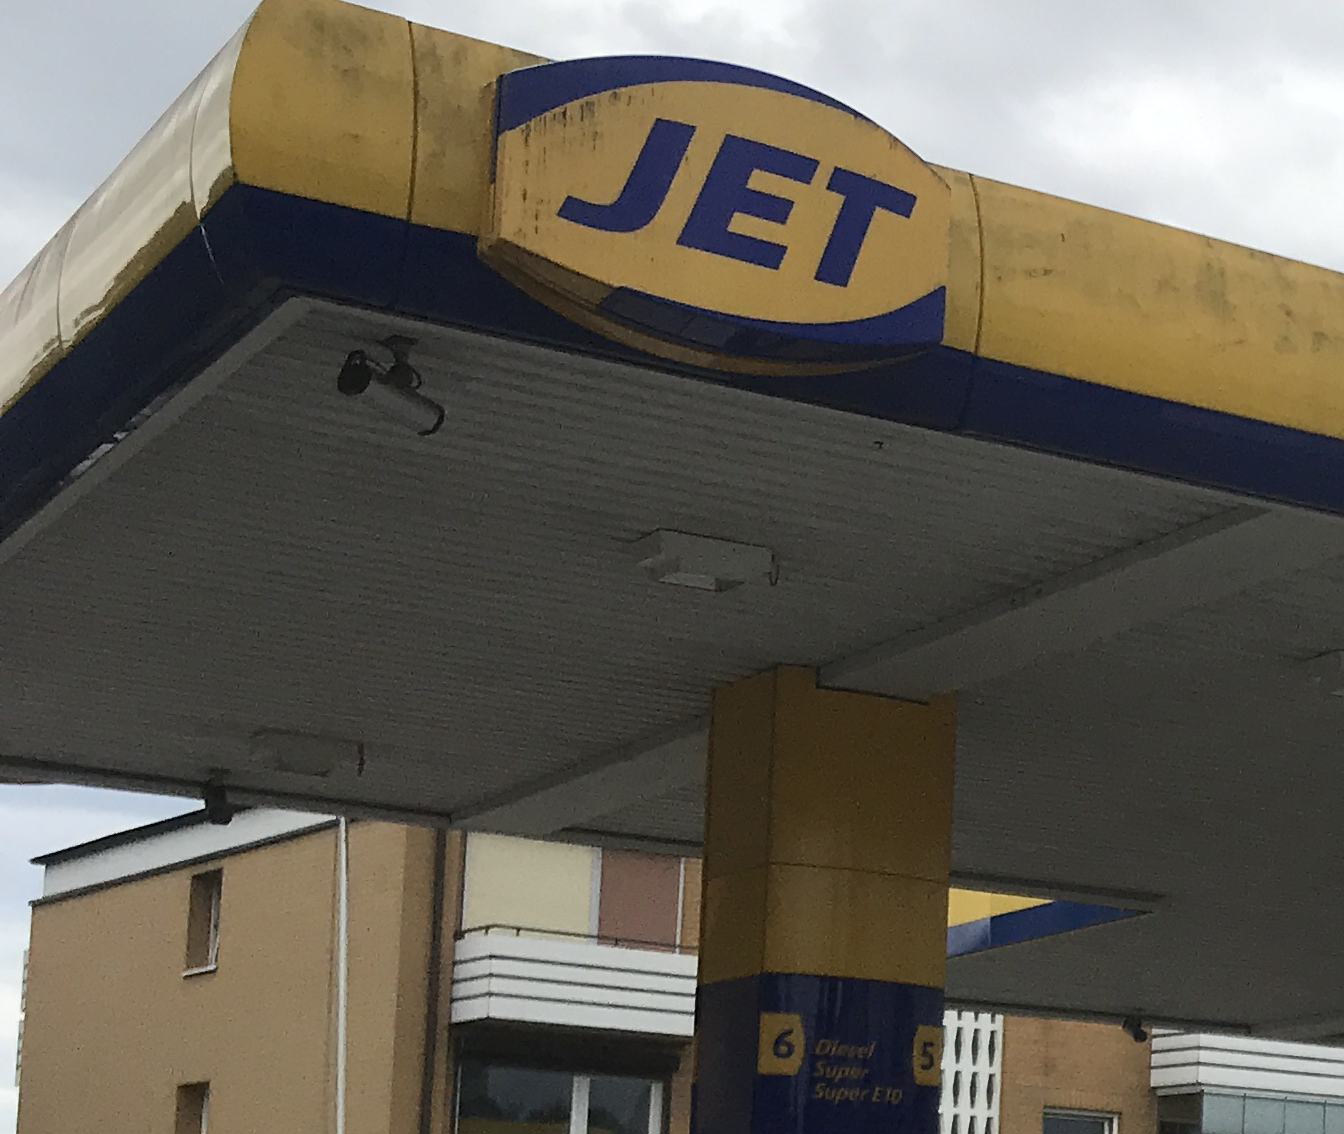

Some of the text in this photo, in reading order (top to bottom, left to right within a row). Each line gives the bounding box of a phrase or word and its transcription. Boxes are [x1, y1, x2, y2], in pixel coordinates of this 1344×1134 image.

[557, 117, 917, 288] JET
[772, 1028, 796, 1059] 6
[815, 1038, 876, 1059] Diesel
[920, 1042, 935, 1071] 5
[813, 1061, 869, 1082] Super
[812, 1083, 903, 1104] Super E10
